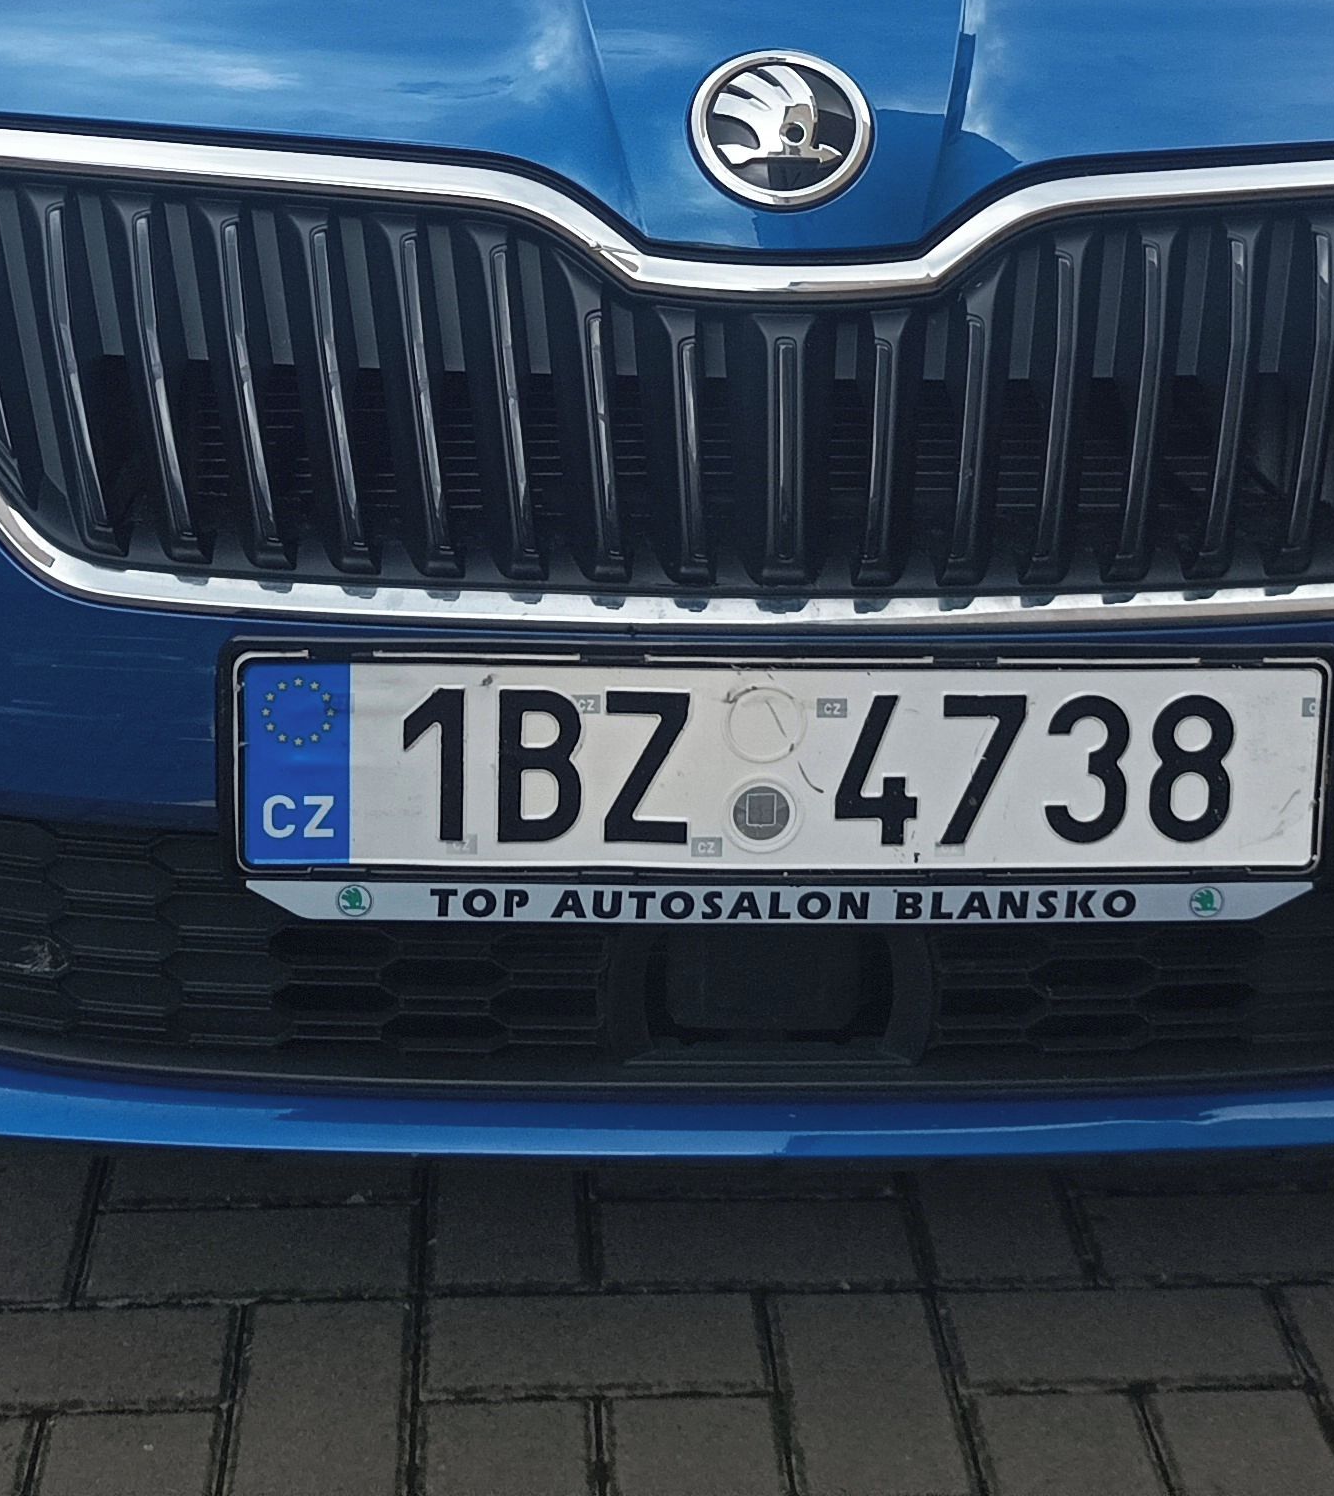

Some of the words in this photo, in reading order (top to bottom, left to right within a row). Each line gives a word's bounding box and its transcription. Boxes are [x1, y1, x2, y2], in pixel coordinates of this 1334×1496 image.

[824, 703, 841, 715] CZ
[404, 688, 690, 843] 1BZ
[834, 694, 1234, 845] 4738
[262, 794, 335, 838] CZ
[698, 841, 715, 854] CZ
[430, 888, 530, 919] TOP
[550, 889, 869, 920] AUTOSALON
[895, 889, 1137, 921] BLANSKO
